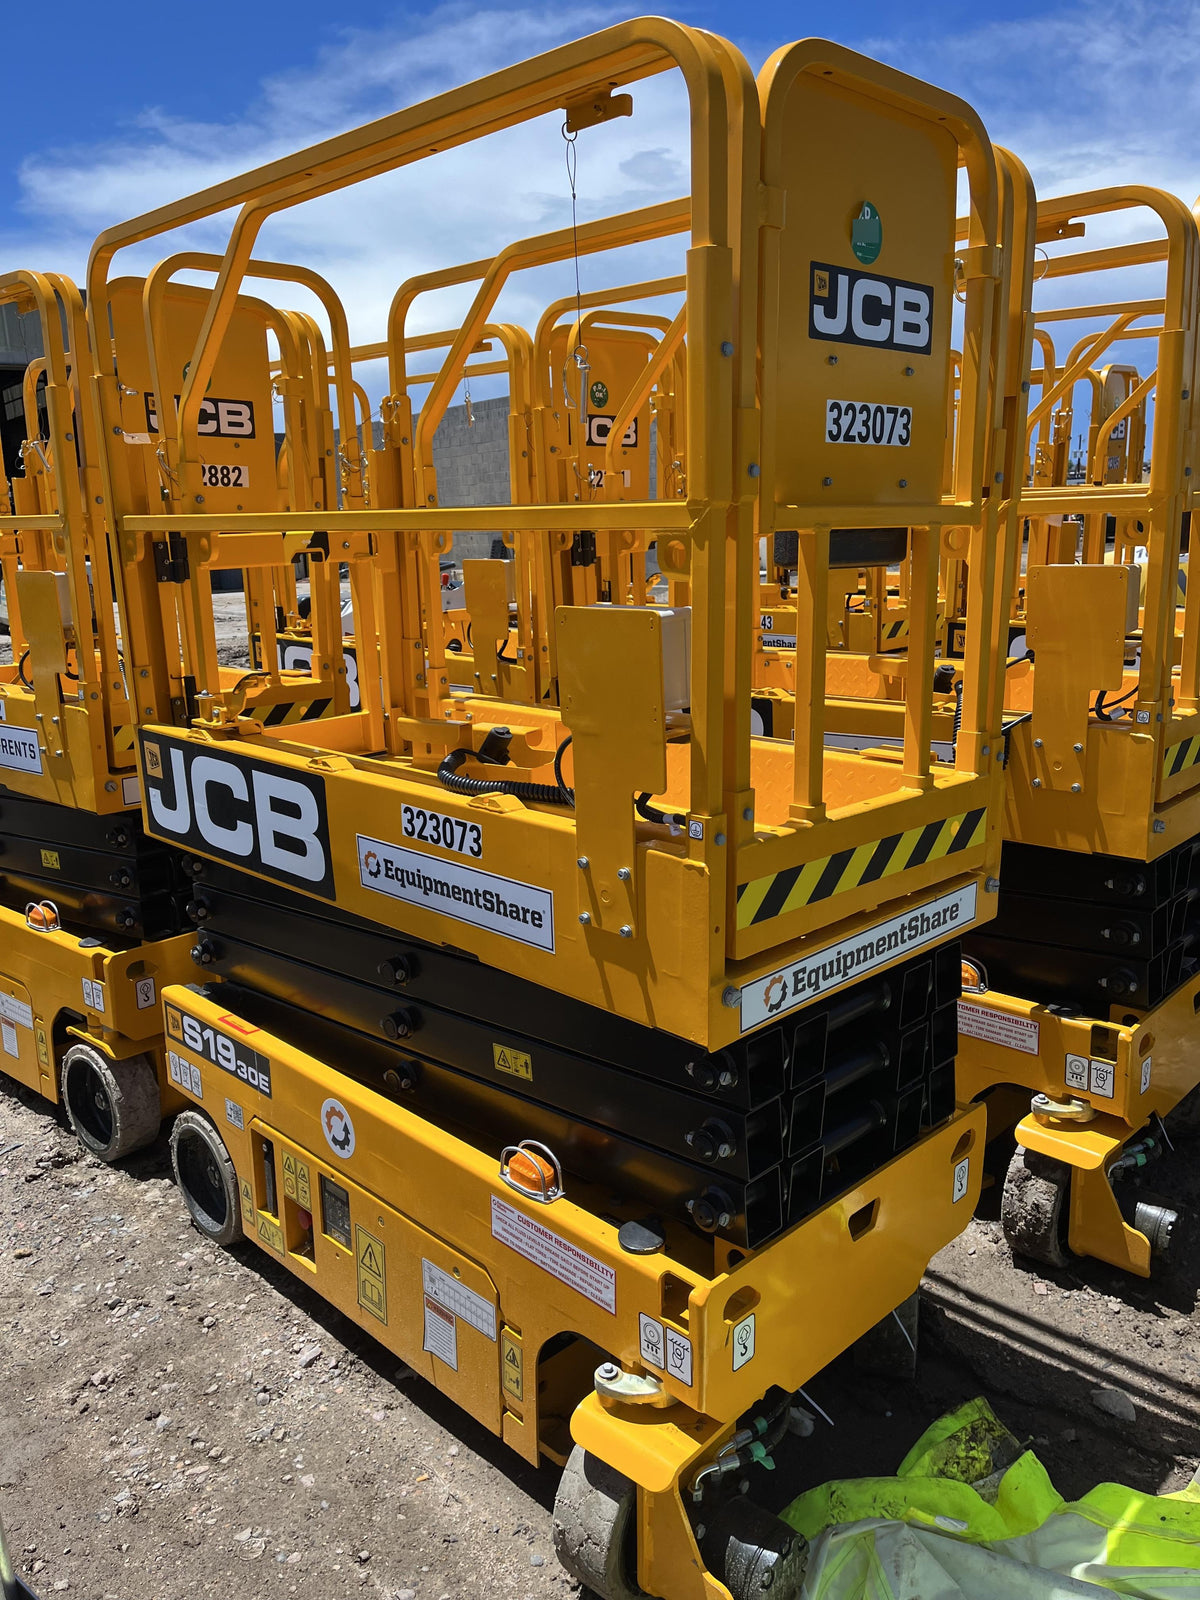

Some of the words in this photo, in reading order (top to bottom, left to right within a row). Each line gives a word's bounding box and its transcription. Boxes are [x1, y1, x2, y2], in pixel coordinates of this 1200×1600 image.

[813, 274, 930, 348] JCB
[586, 417, 637, 446] CB
[827, 401, 912, 446] 323073
[0, 738, 36, 760] RENTS
[149, 747, 326, 882] JCB
[402, 806, 482, 858] 323073
[383, 858, 543, 929] EquipmentShare
[791, 902, 960, 997] EquipmentShare
[981, 1009, 1037, 1030] RESPONSIBILITY
[517, 1214, 553, 1242] CUSTOMER
[554, 1237, 613, 1280] RESPONSIBILITY
